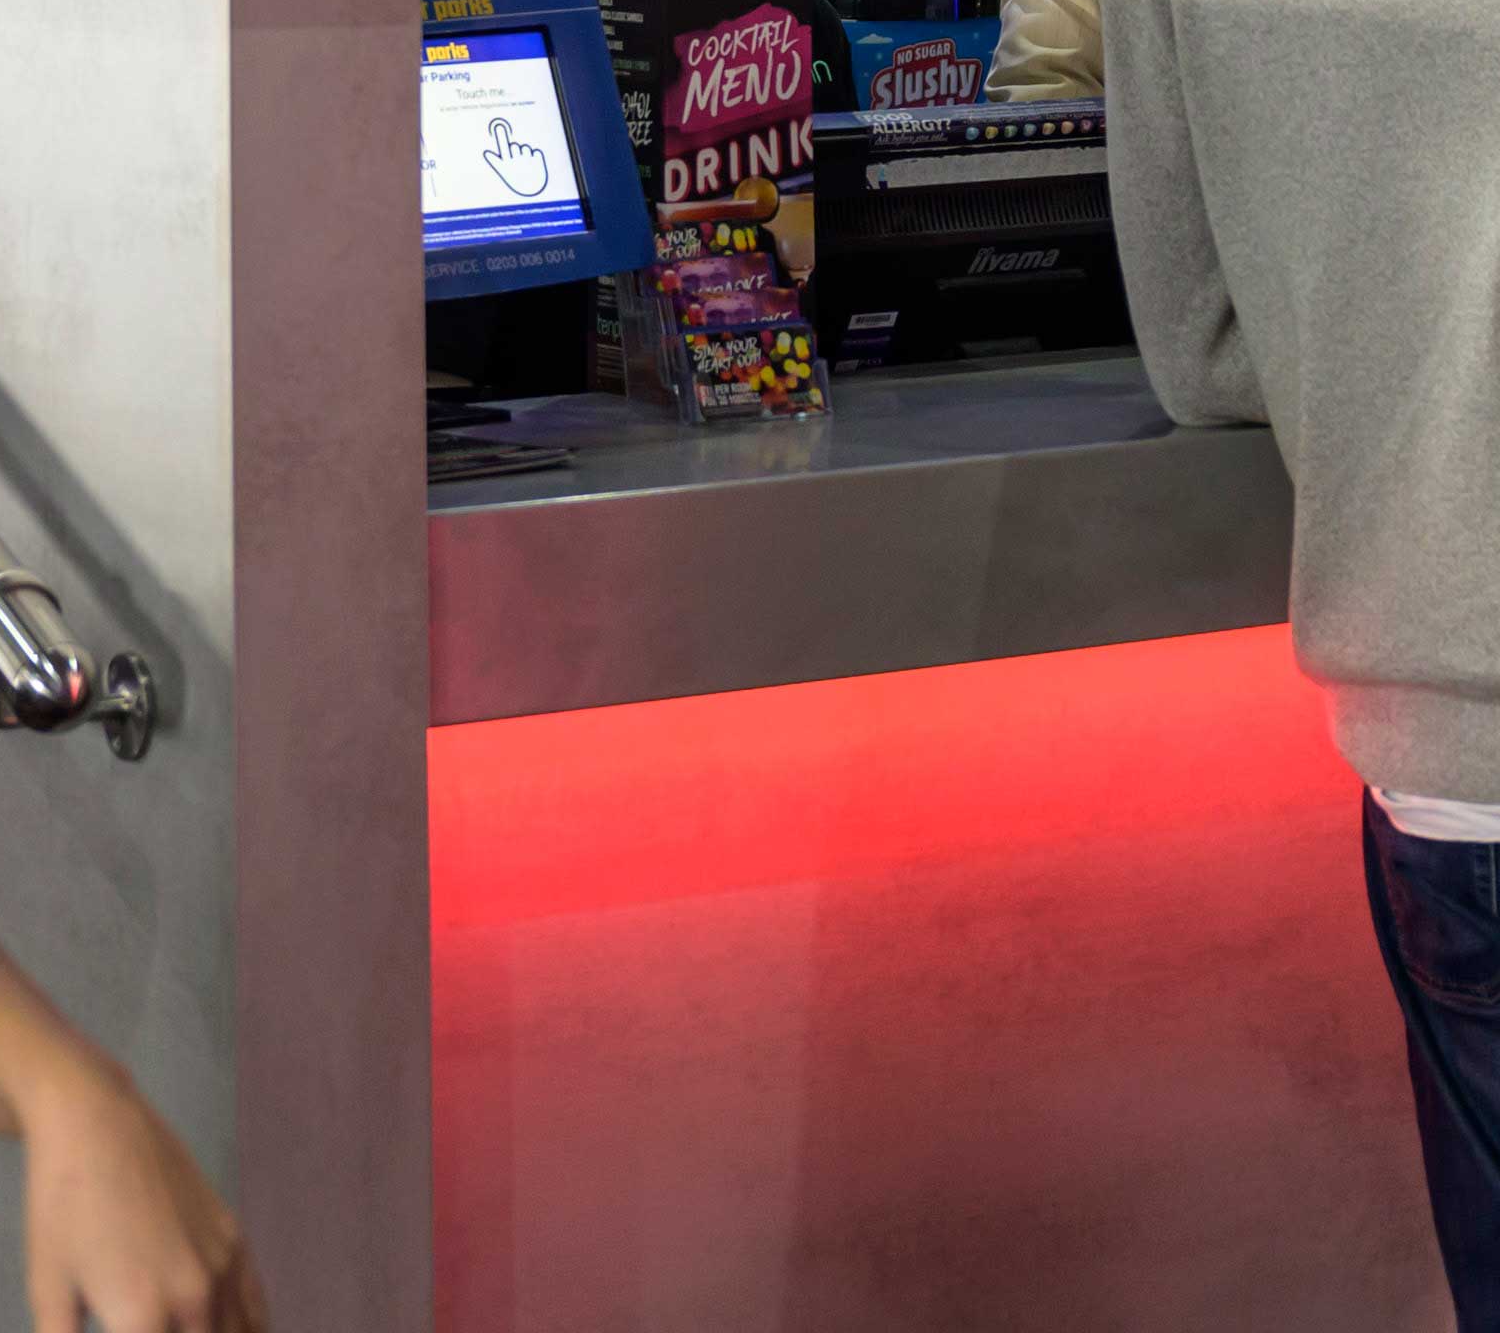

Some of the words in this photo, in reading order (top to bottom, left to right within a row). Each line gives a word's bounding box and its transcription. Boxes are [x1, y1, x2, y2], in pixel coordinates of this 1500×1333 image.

[687, 14, 800, 67] COCKTAIL
[425, 41, 470, 64] parks
[896, 47, 913, 63] NO
[914, 43, 951, 61] SUGAR
[430, 70, 471, 84] Parking
[681, 47, 802, 125] MENU
[872, 59, 978, 109] Slushy
[455, 87, 485, 100] Touch
[622, 91, 652, 120] OHOL
[863, 112, 914, 124] FOOD
[871, 118, 952, 135] ALLERGY?
[627, 120, 653, 148] REE
[663, 116, 814, 203] DRINK
[665, 227, 698, 246] YOUR
[486, 255, 518, 272] 0203
[520, 253, 544, 268] 006
[545, 248, 576, 264] 0014
[967, 246, 1061, 275] iiyama
[726, 336, 759, 355] YOUR
[696, 354, 735, 374] HEART
